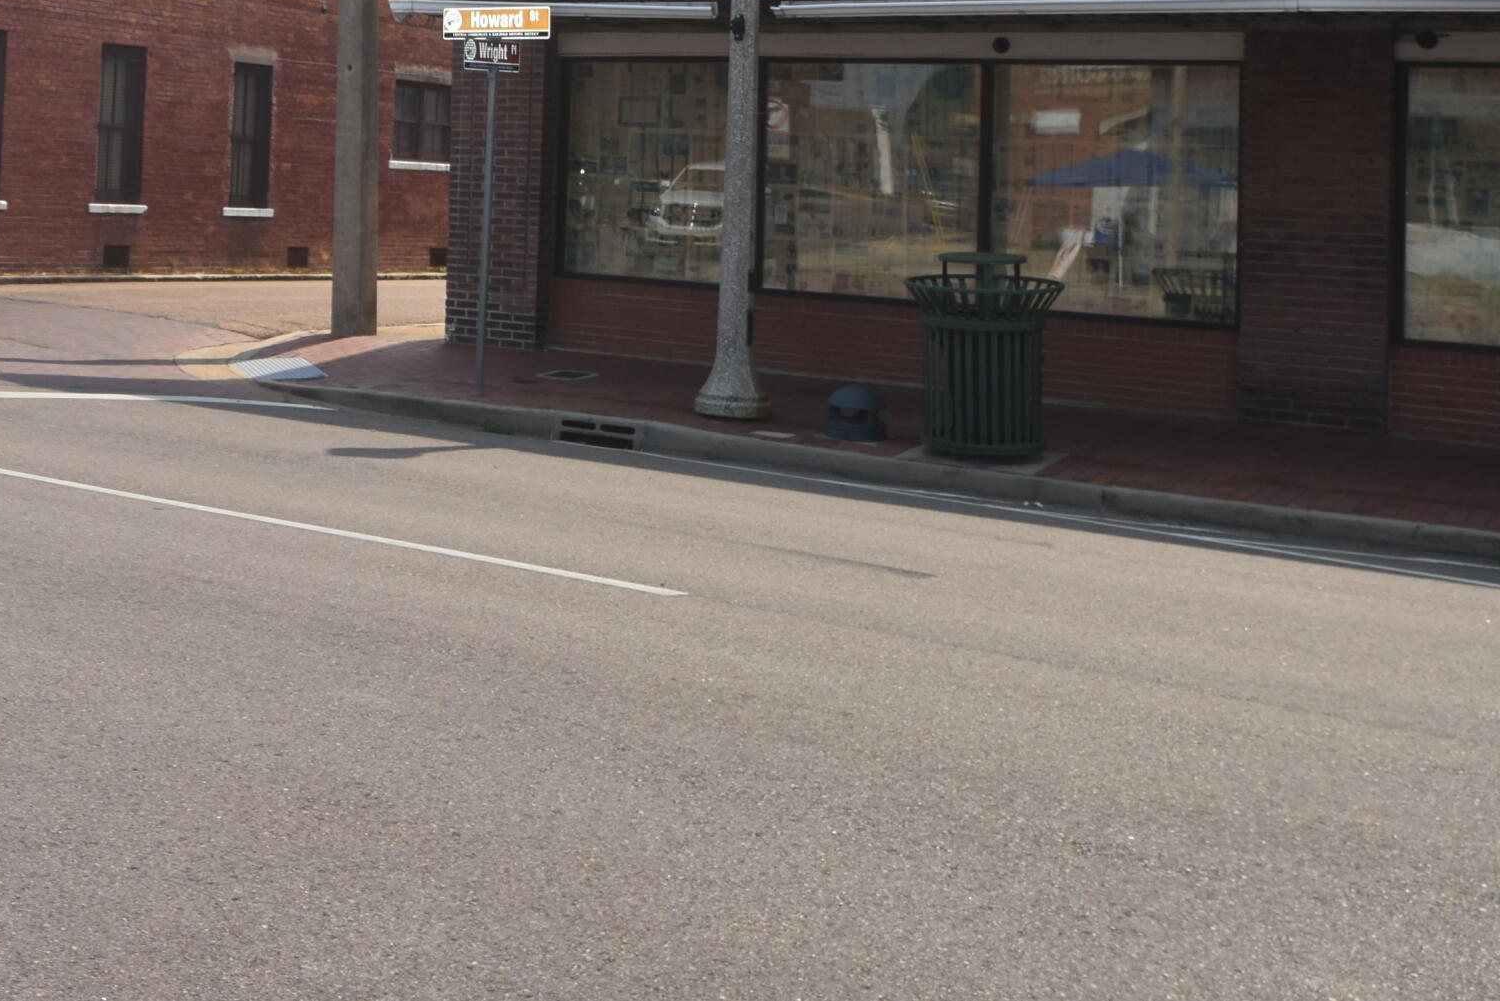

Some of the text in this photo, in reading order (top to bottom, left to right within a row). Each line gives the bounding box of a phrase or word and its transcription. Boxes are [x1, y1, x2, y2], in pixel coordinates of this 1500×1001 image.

[470, 10, 539, 28] Howard St
[479, 42, 508, 63] Wright
